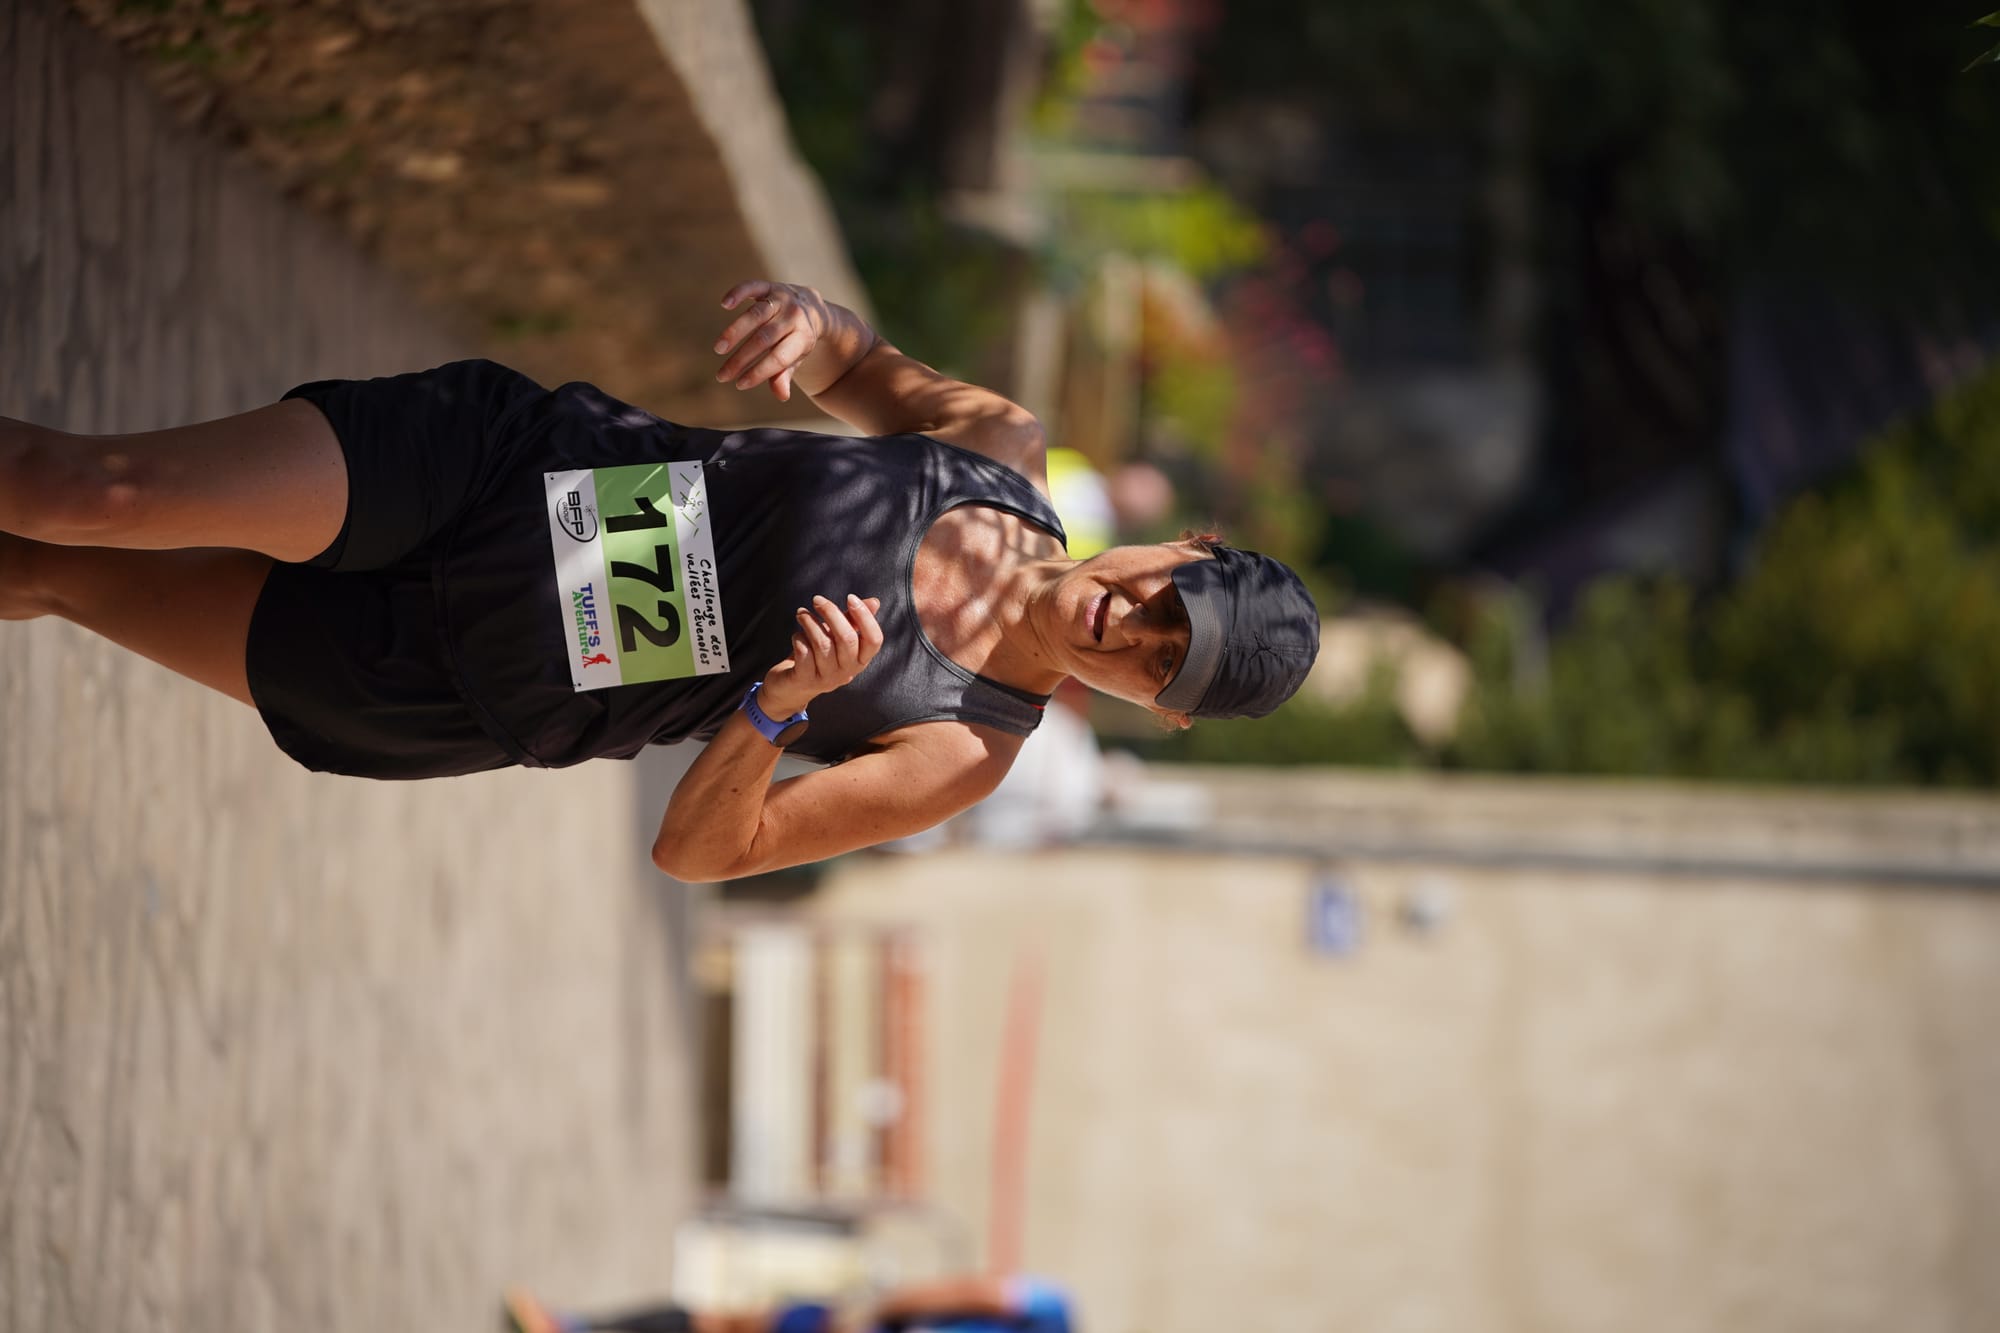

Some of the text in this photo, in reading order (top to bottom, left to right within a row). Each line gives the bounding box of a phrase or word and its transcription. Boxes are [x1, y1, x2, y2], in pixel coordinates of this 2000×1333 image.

[567, 491, 584, 535] BFP
[580, 582, 601, 647] TUFF'S
[604, 496, 681, 653] 172
[686, 553, 710, 665] vallées cévenoles
[699, 559, 722, 657] Challenge des
[572, 591, 590, 656] Aventure
